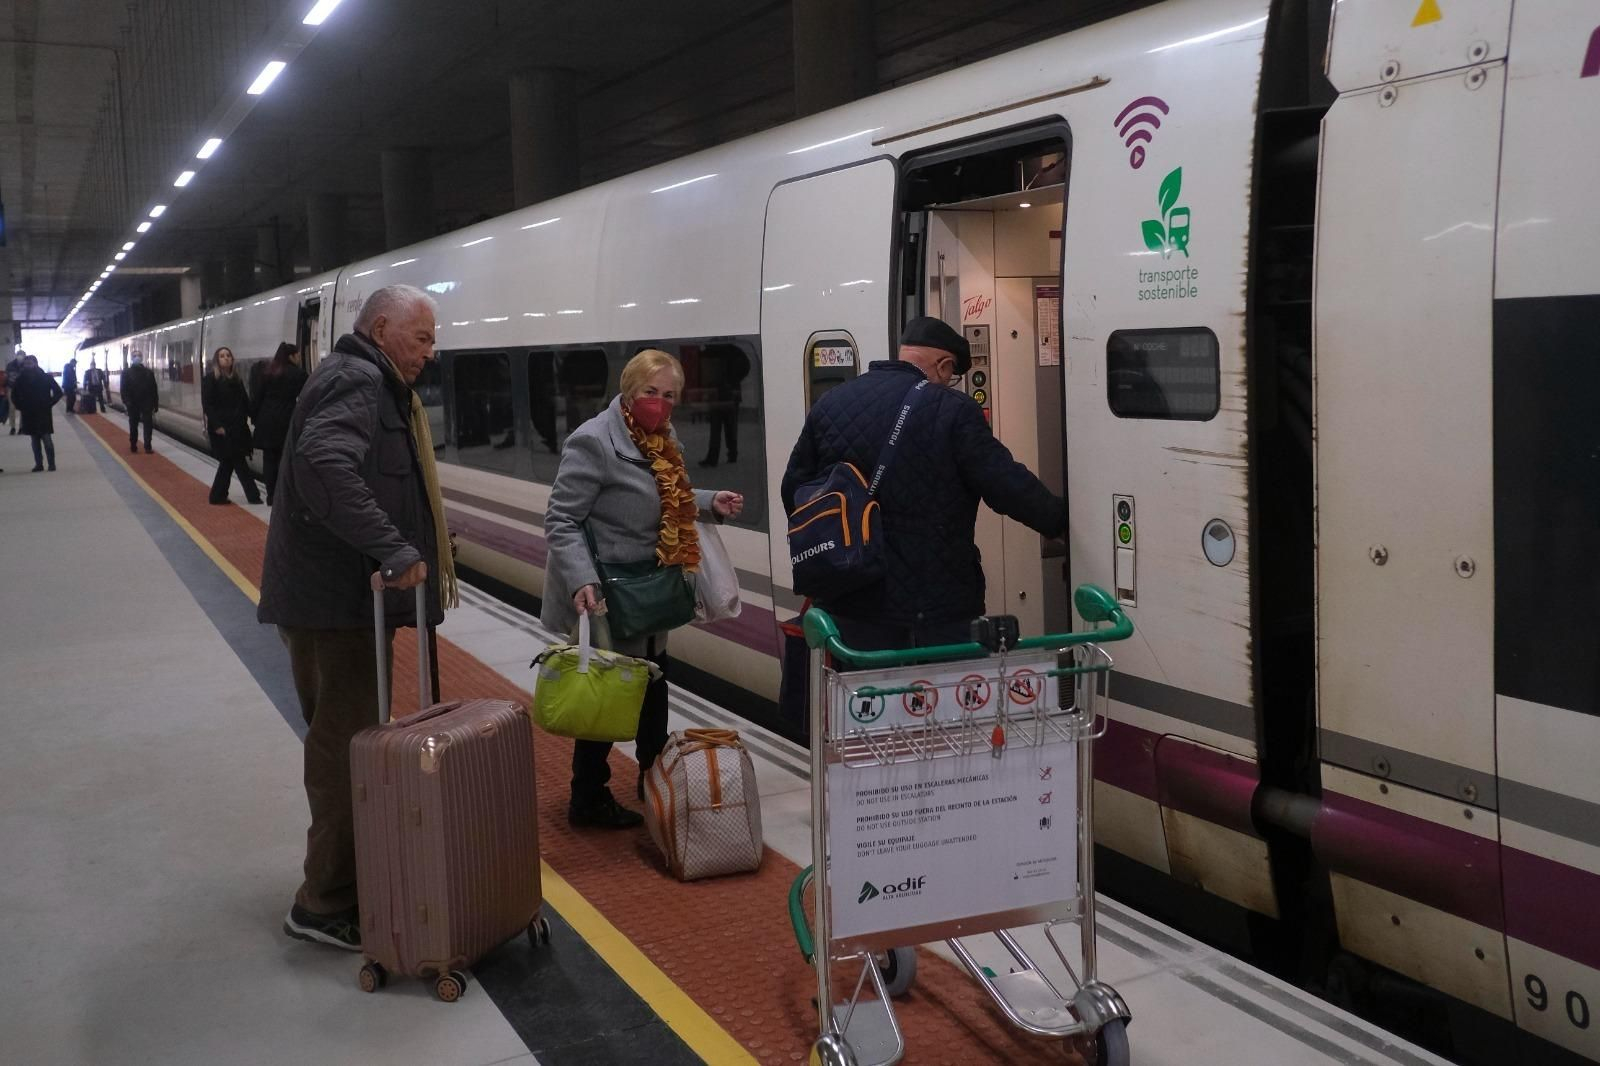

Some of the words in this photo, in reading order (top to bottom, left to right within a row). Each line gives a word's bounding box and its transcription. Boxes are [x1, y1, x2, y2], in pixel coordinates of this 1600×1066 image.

[1139, 264, 1198, 286] transporte
[1138, 279, 1198, 301] sostenible
[963, 294, 992, 321] Talgo
[888, 404, 911, 446] POLITOURS
[868, 464, 886, 496] LITOURS
[791, 540, 836, 566] OLITOURS
[883, 875, 927, 894] adif
